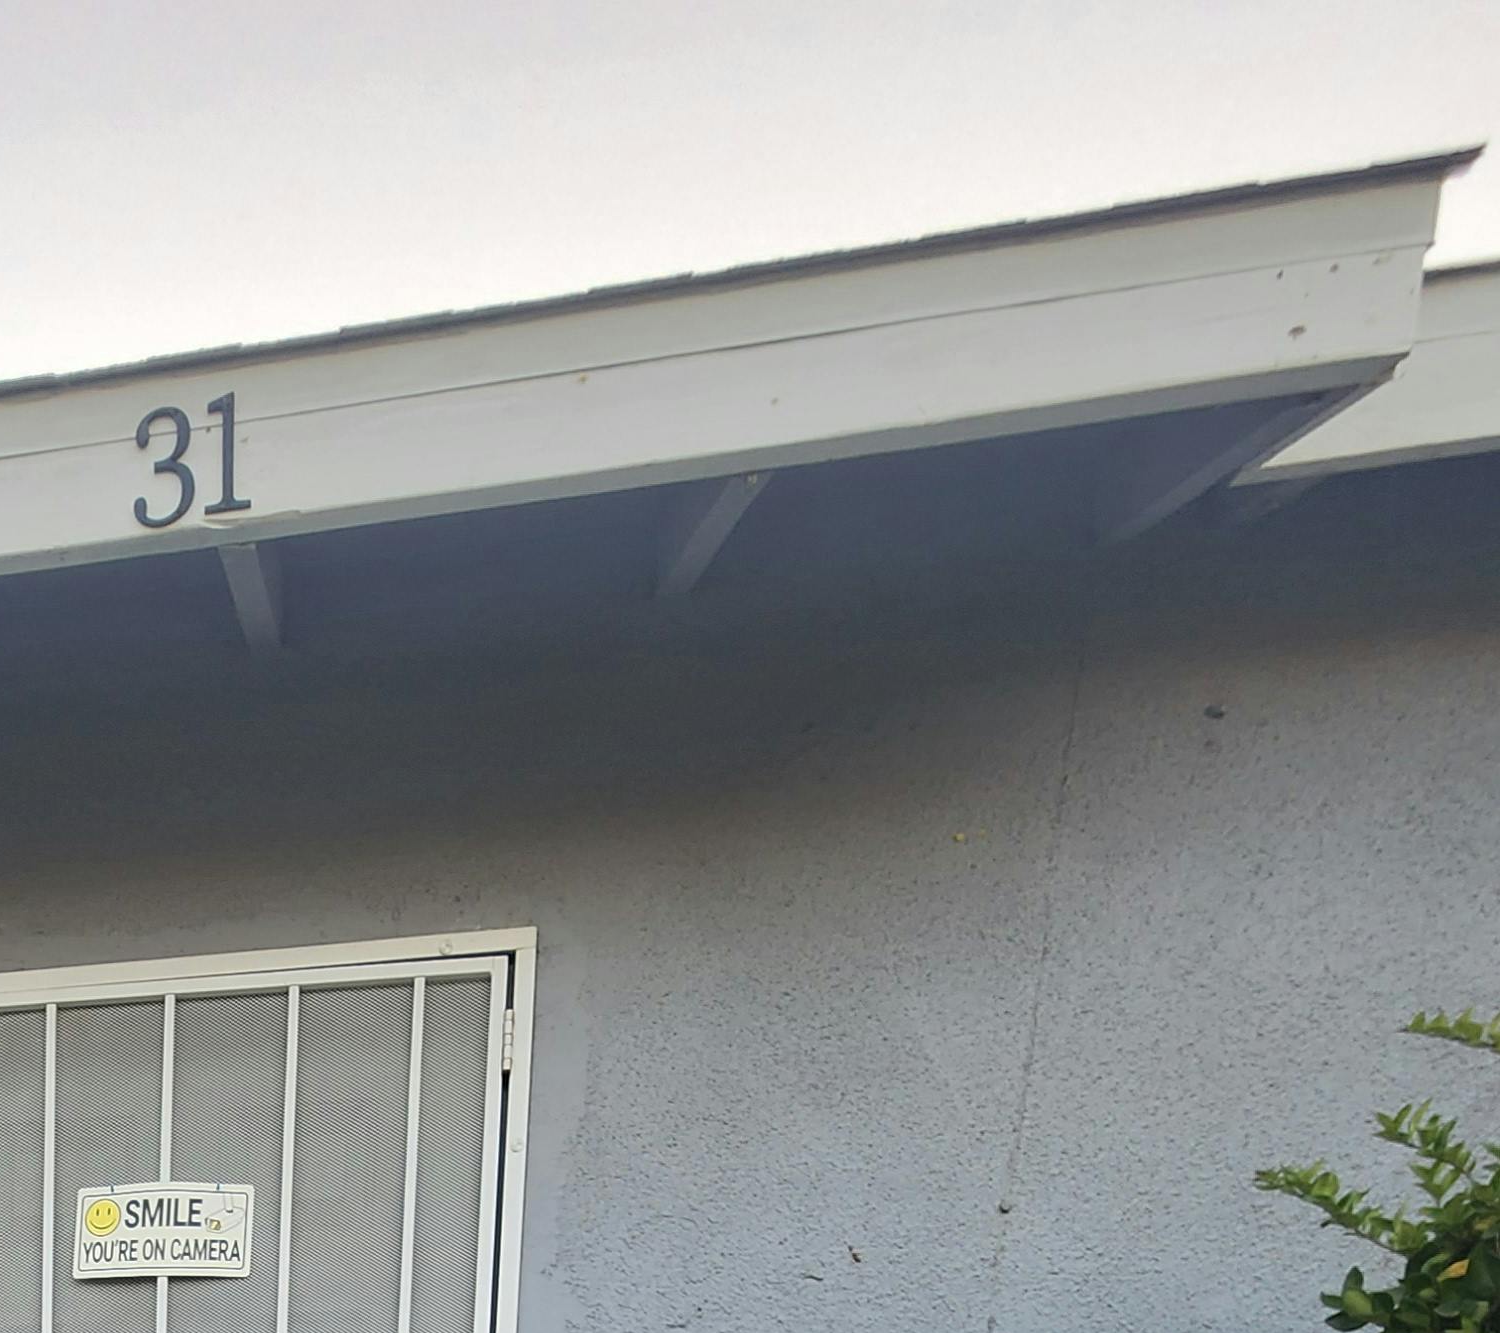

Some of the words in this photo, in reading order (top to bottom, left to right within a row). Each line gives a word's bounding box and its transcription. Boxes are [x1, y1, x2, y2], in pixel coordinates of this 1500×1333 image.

[134, 391, 251, 528] 31
[124, 1198, 203, 1228] SMILE
[83, 1239, 138, 1263] YOU'RE
[142, 1238, 166, 1261] ON
[170, 1238, 241, 1261] CAMERA
